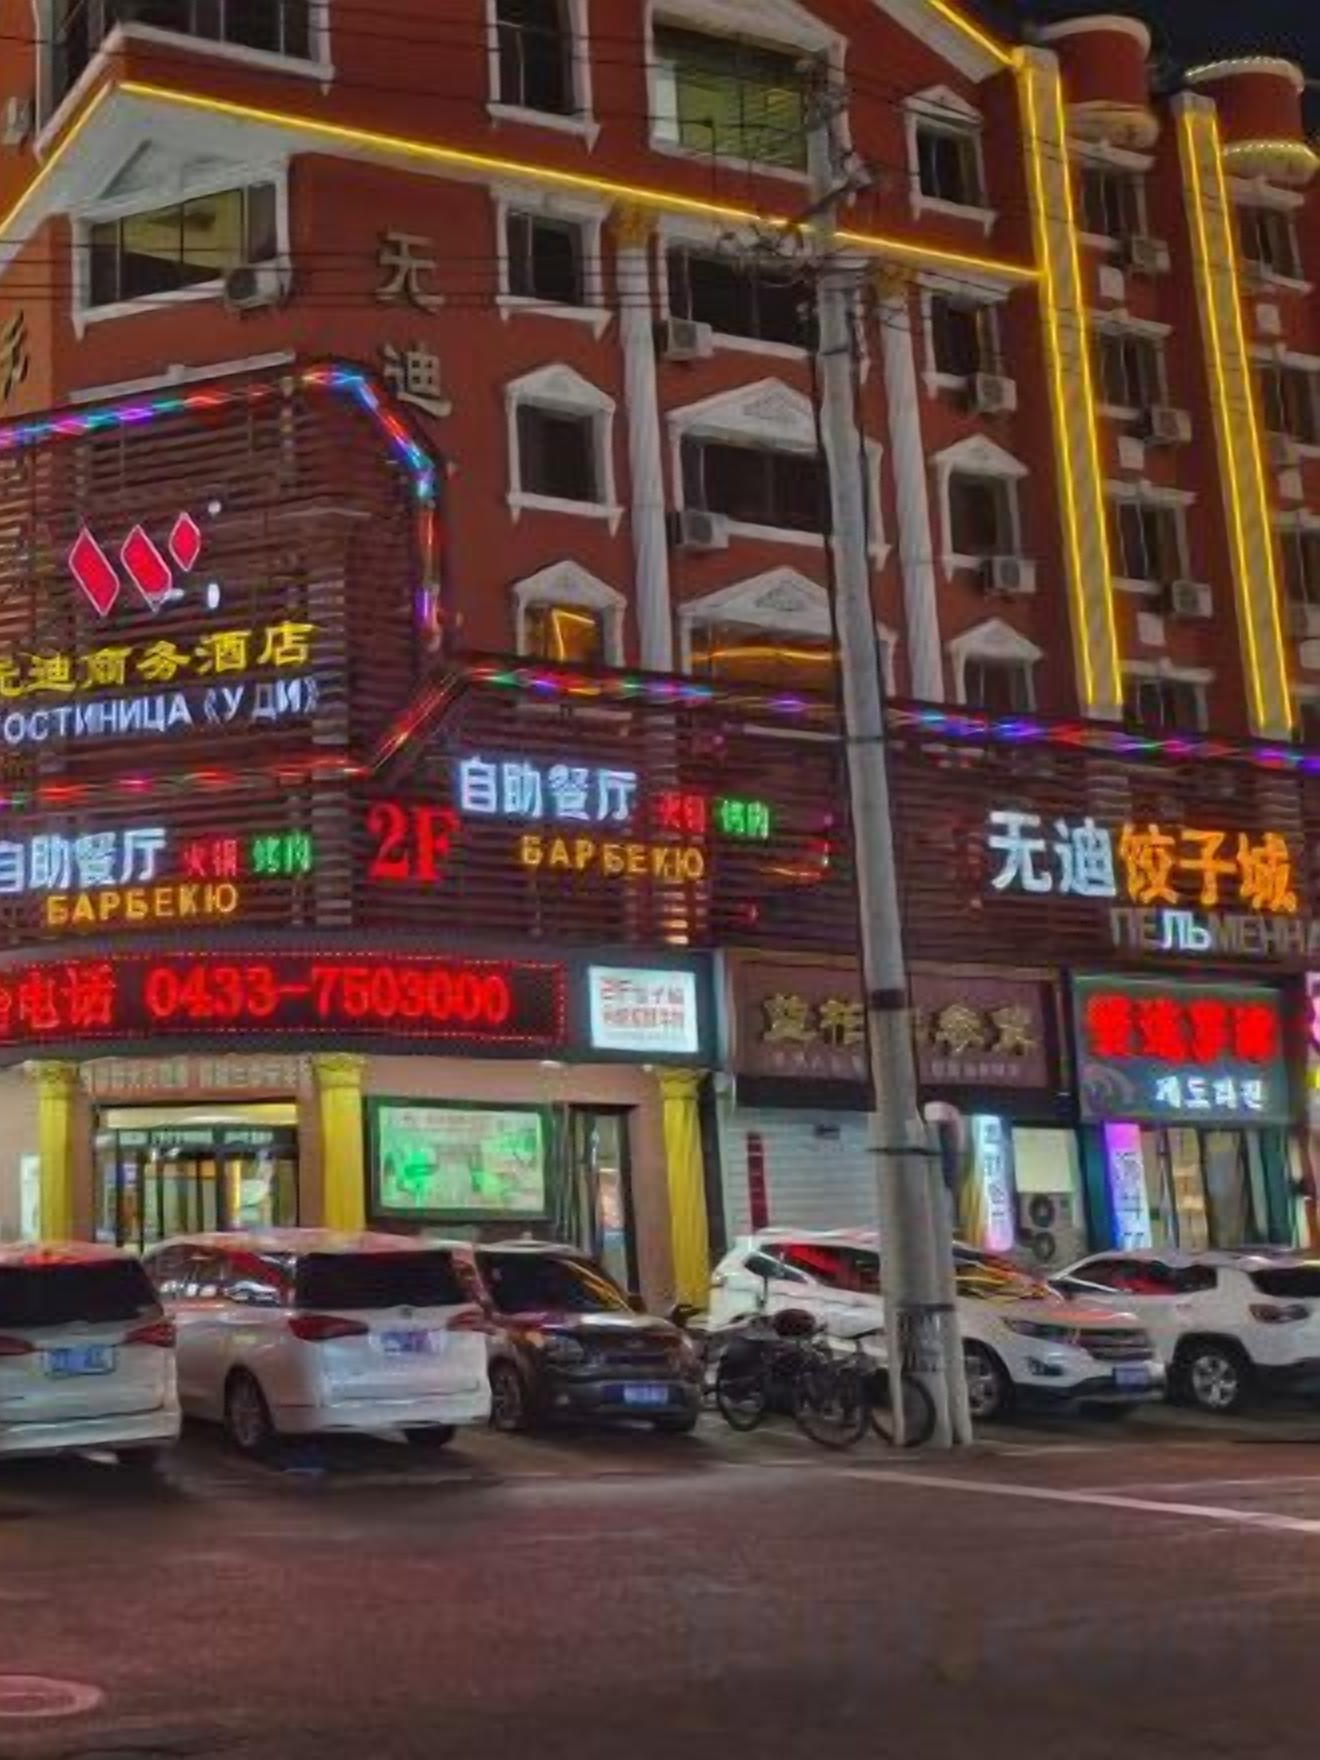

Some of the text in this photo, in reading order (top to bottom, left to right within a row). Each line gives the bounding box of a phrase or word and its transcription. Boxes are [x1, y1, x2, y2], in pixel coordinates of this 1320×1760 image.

[458, 757, 638, 821] 自助餐厅
[363, 803, 461, 884] 2F
[519, 834, 706, 879] БАРБЕКЮ
[45, 883, 241, 926] БАРБЕКЮ
[142, 964, 512, 1024] 0433-7503000
